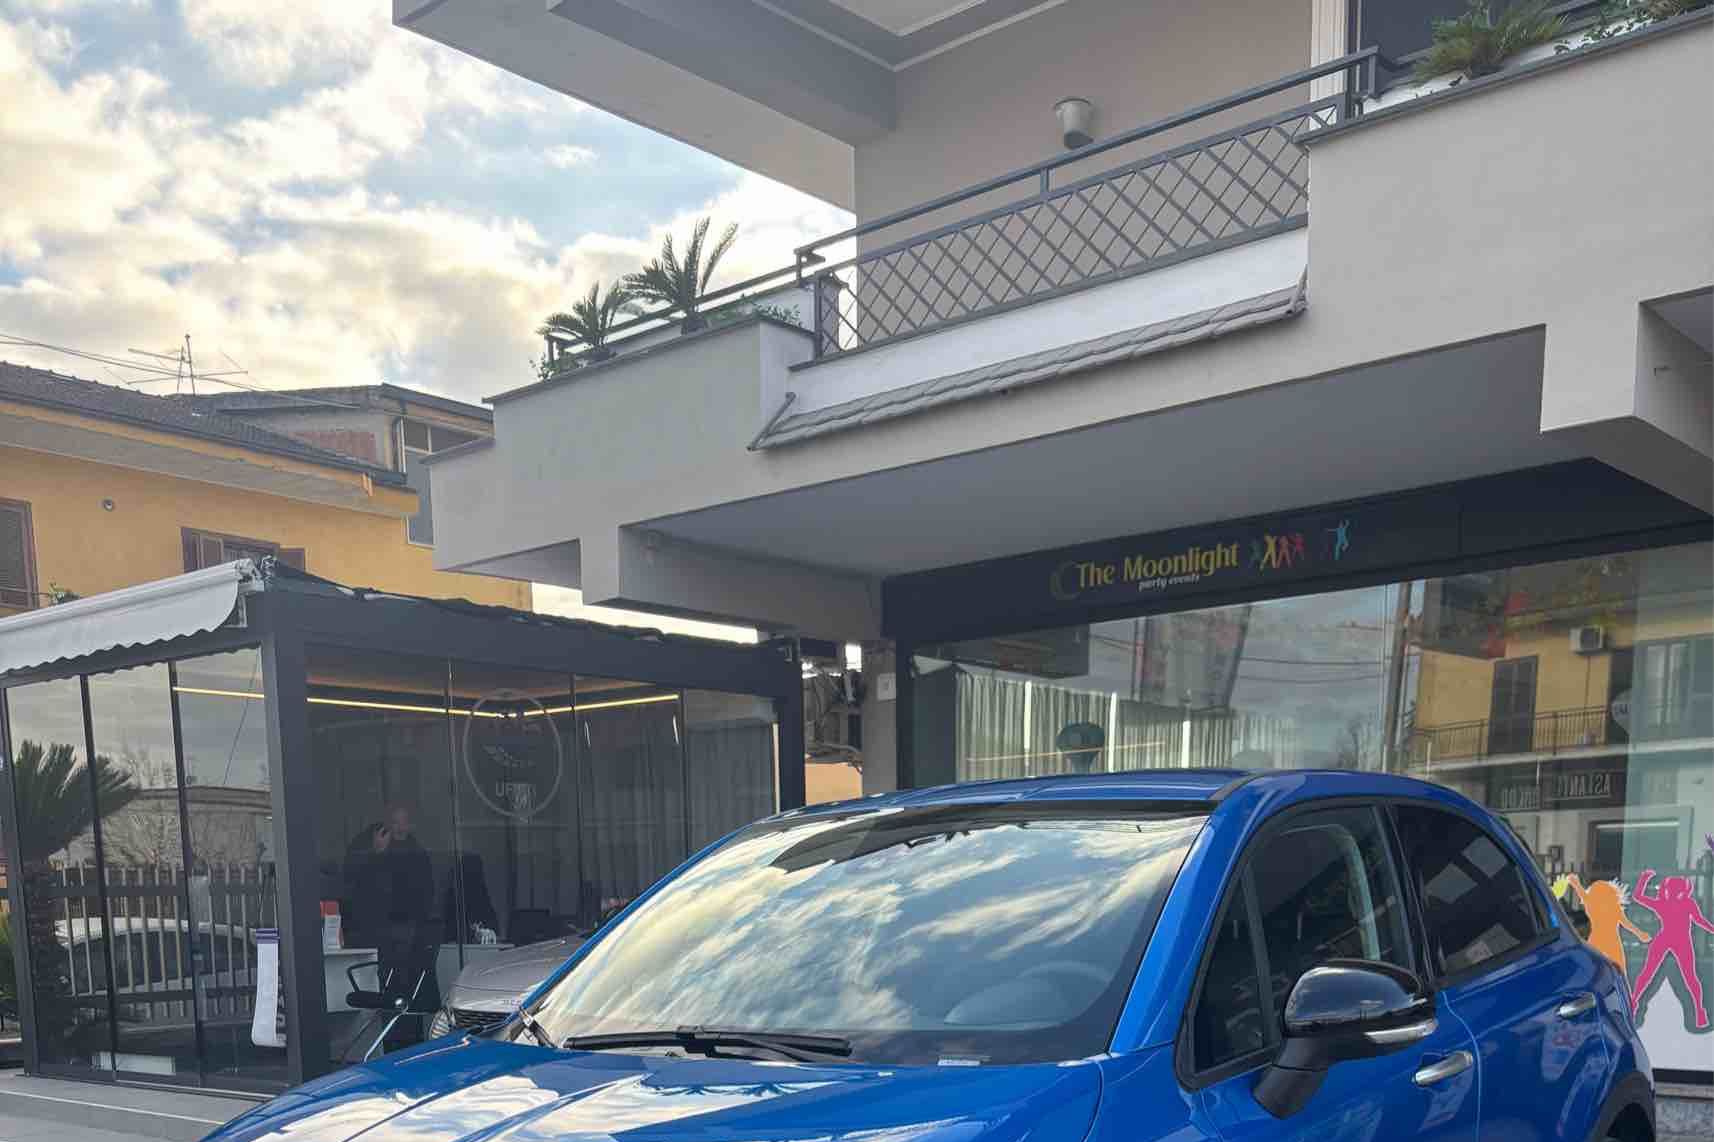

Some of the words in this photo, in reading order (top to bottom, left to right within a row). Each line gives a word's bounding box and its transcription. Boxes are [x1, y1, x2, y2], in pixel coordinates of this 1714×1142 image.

[1077, 560, 1115, 588] The
[1123, 543, 1240, 581] Moonlight
[1138, 577, 1168, 592] party
